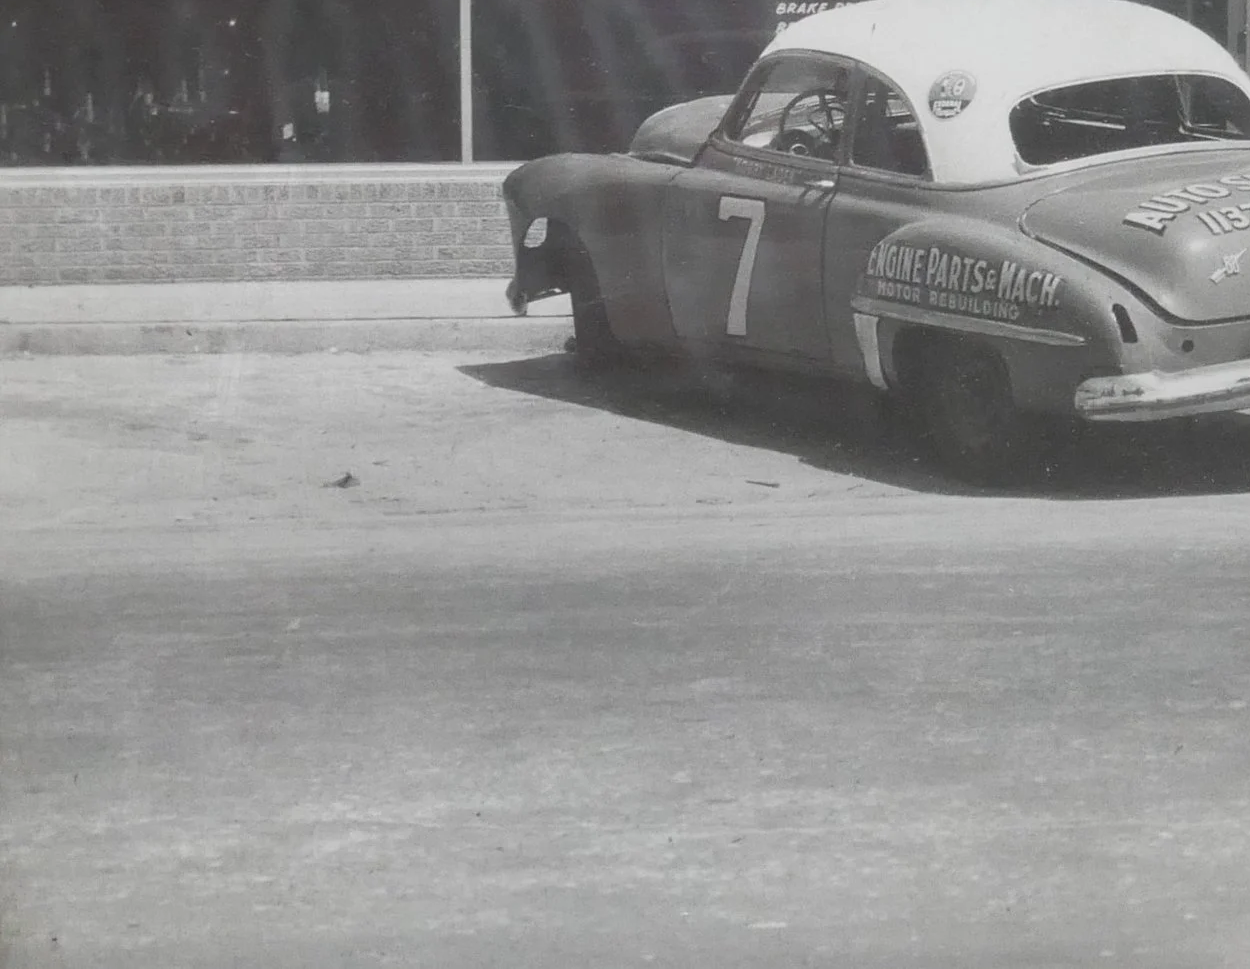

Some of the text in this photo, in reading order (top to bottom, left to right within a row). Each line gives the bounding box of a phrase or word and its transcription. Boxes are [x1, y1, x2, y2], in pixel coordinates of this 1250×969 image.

[776, 2, 828, 15] BRAKE
[1122, 183, 1232, 235] AUTO
[718, 195, 766, 336] 7
[867, 243, 926, 284] ENGINE
[926, 247, 987, 294] PARTS
[878, 281, 1021, 321] MOTOR REBUILDING
